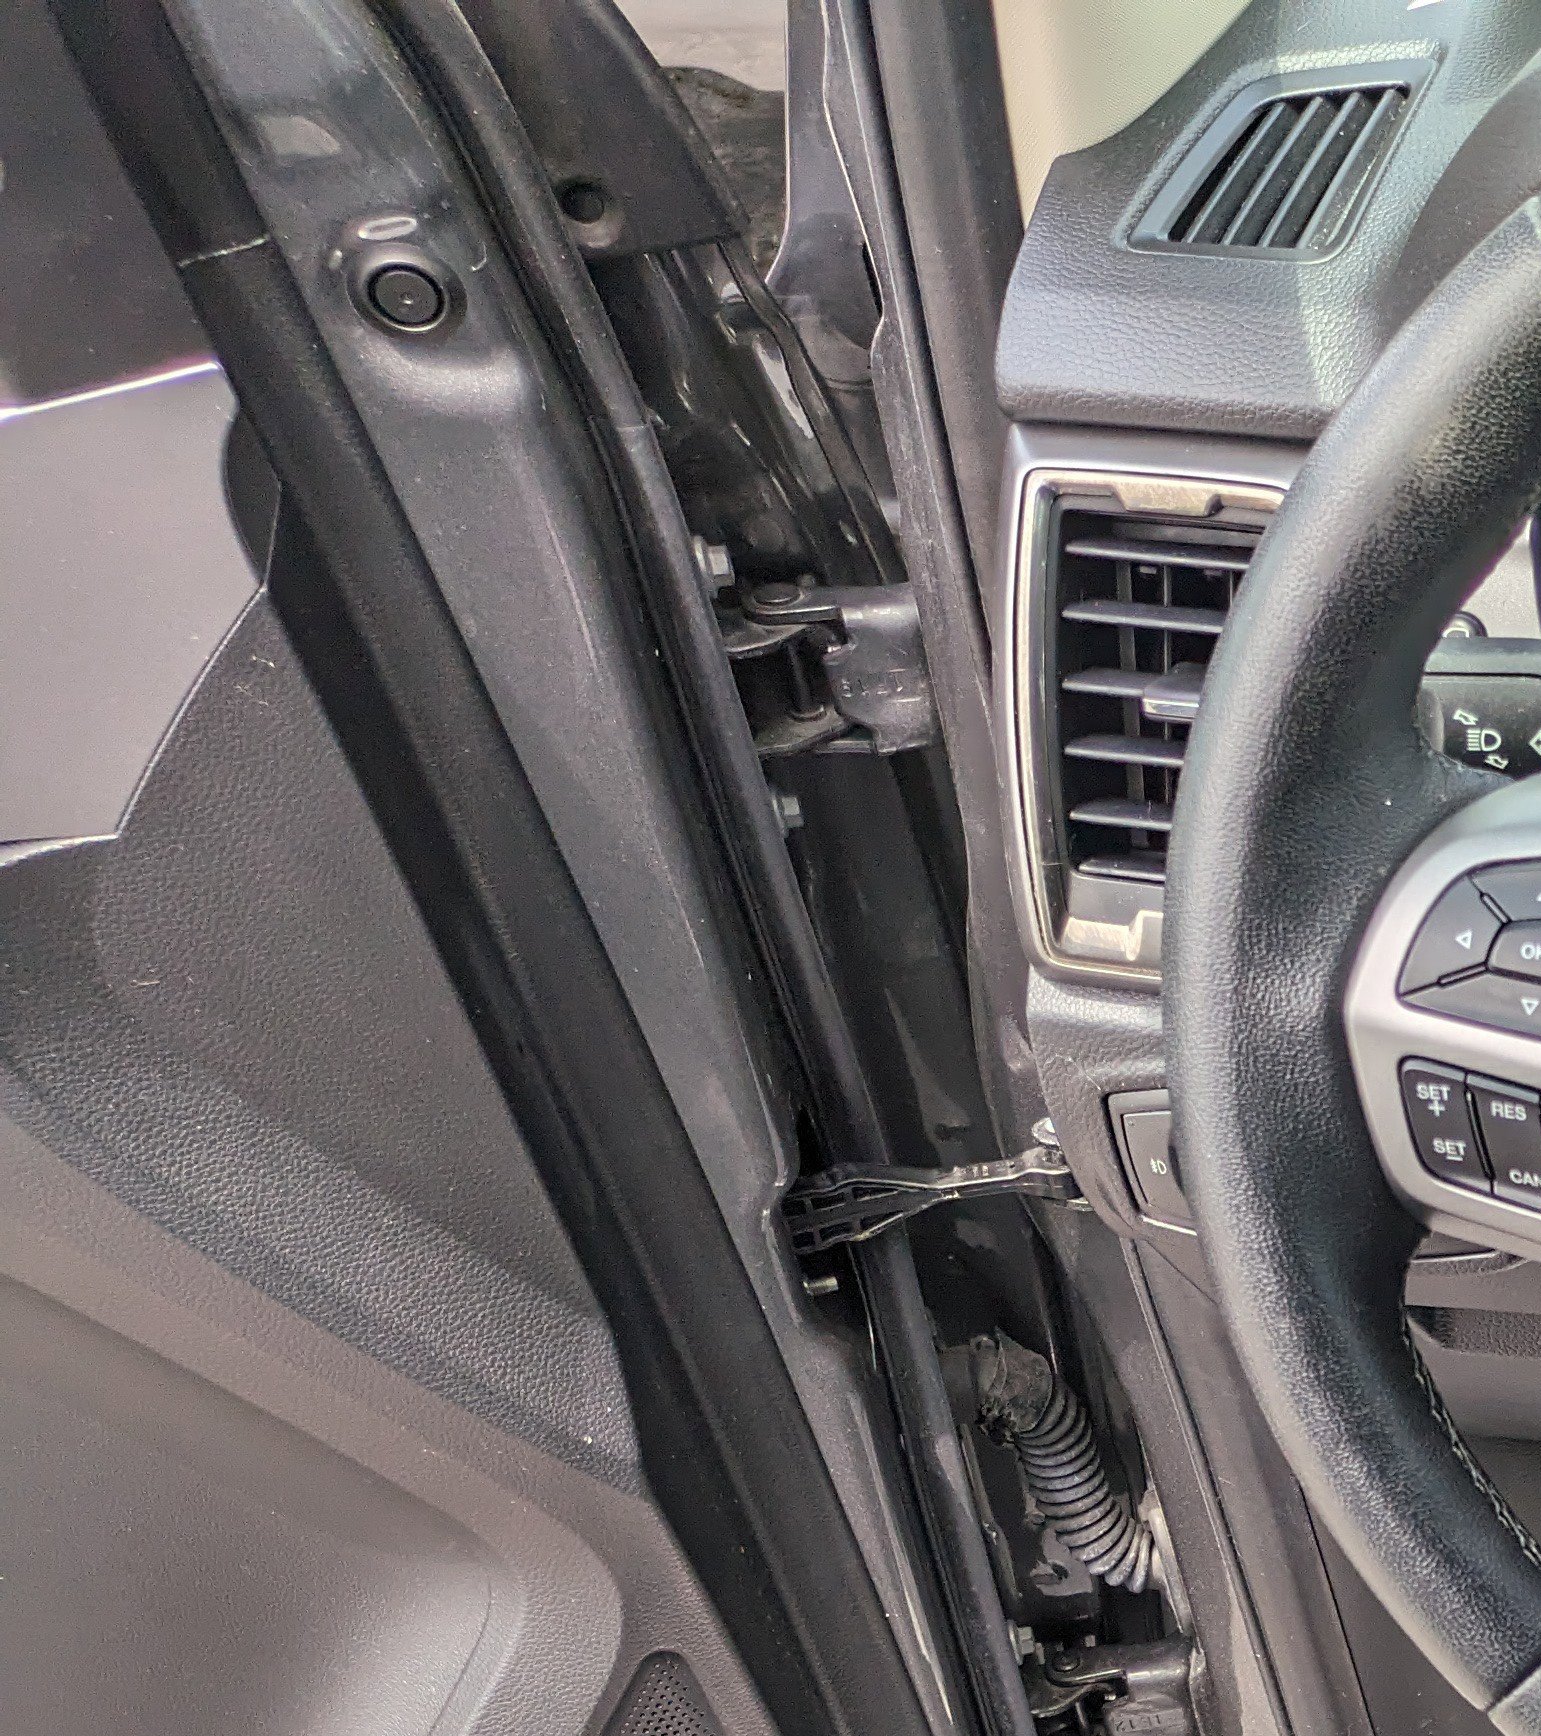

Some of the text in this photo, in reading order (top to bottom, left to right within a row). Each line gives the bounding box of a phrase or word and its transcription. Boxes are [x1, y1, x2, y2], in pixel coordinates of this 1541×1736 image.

[1415, 1083, 1451, 1101] SET
[1490, 1102, 1527, 1122] RES
[1433, 1139, 1466, 1158] SET
